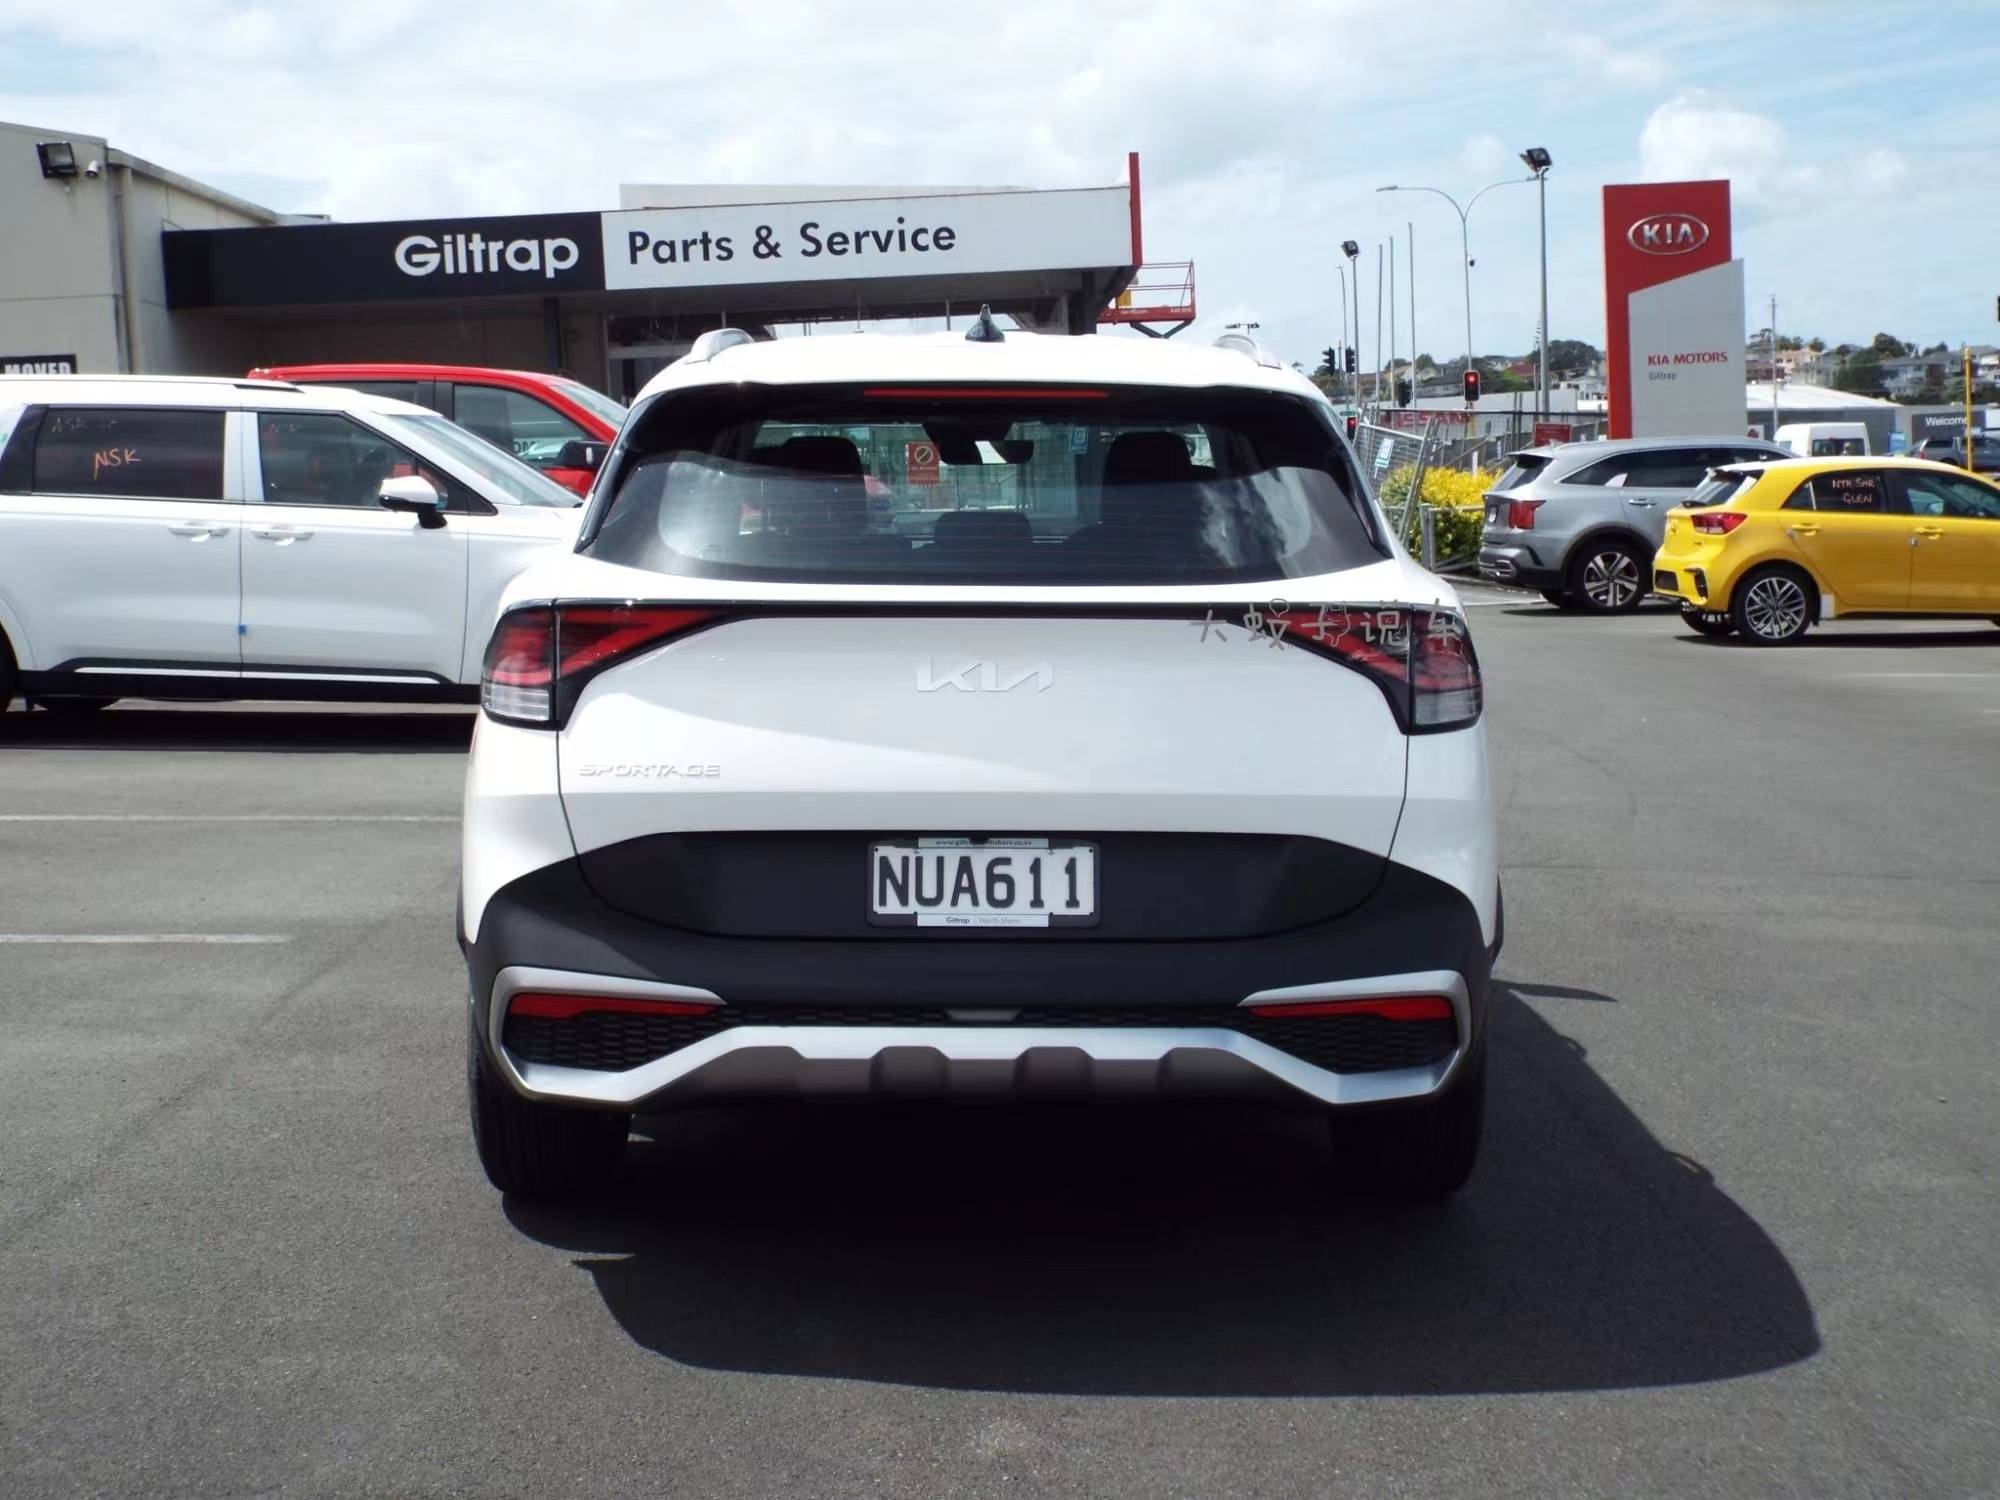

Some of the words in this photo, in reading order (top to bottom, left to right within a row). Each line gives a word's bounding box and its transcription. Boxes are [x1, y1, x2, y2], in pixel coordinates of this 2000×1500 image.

[628, 230, 734, 265] Parts
[752, 224, 783, 260] &
[800, 216, 956, 258] Service
[1642, 222, 1696, 245] KIA
[394, 233, 580, 279] Giltrap
[1648, 354, 1670, 366] KIA
[1673, 351, 1729, 365] MOTORS
[1649, 371, 1678, 381] Giltrap
[93, 447, 141, 480] NSK
[578, 764, 721, 778] SPORTAGE
[878, 855, 1081, 910] NUA611
[945, 916, 970, 925] Giltrap
